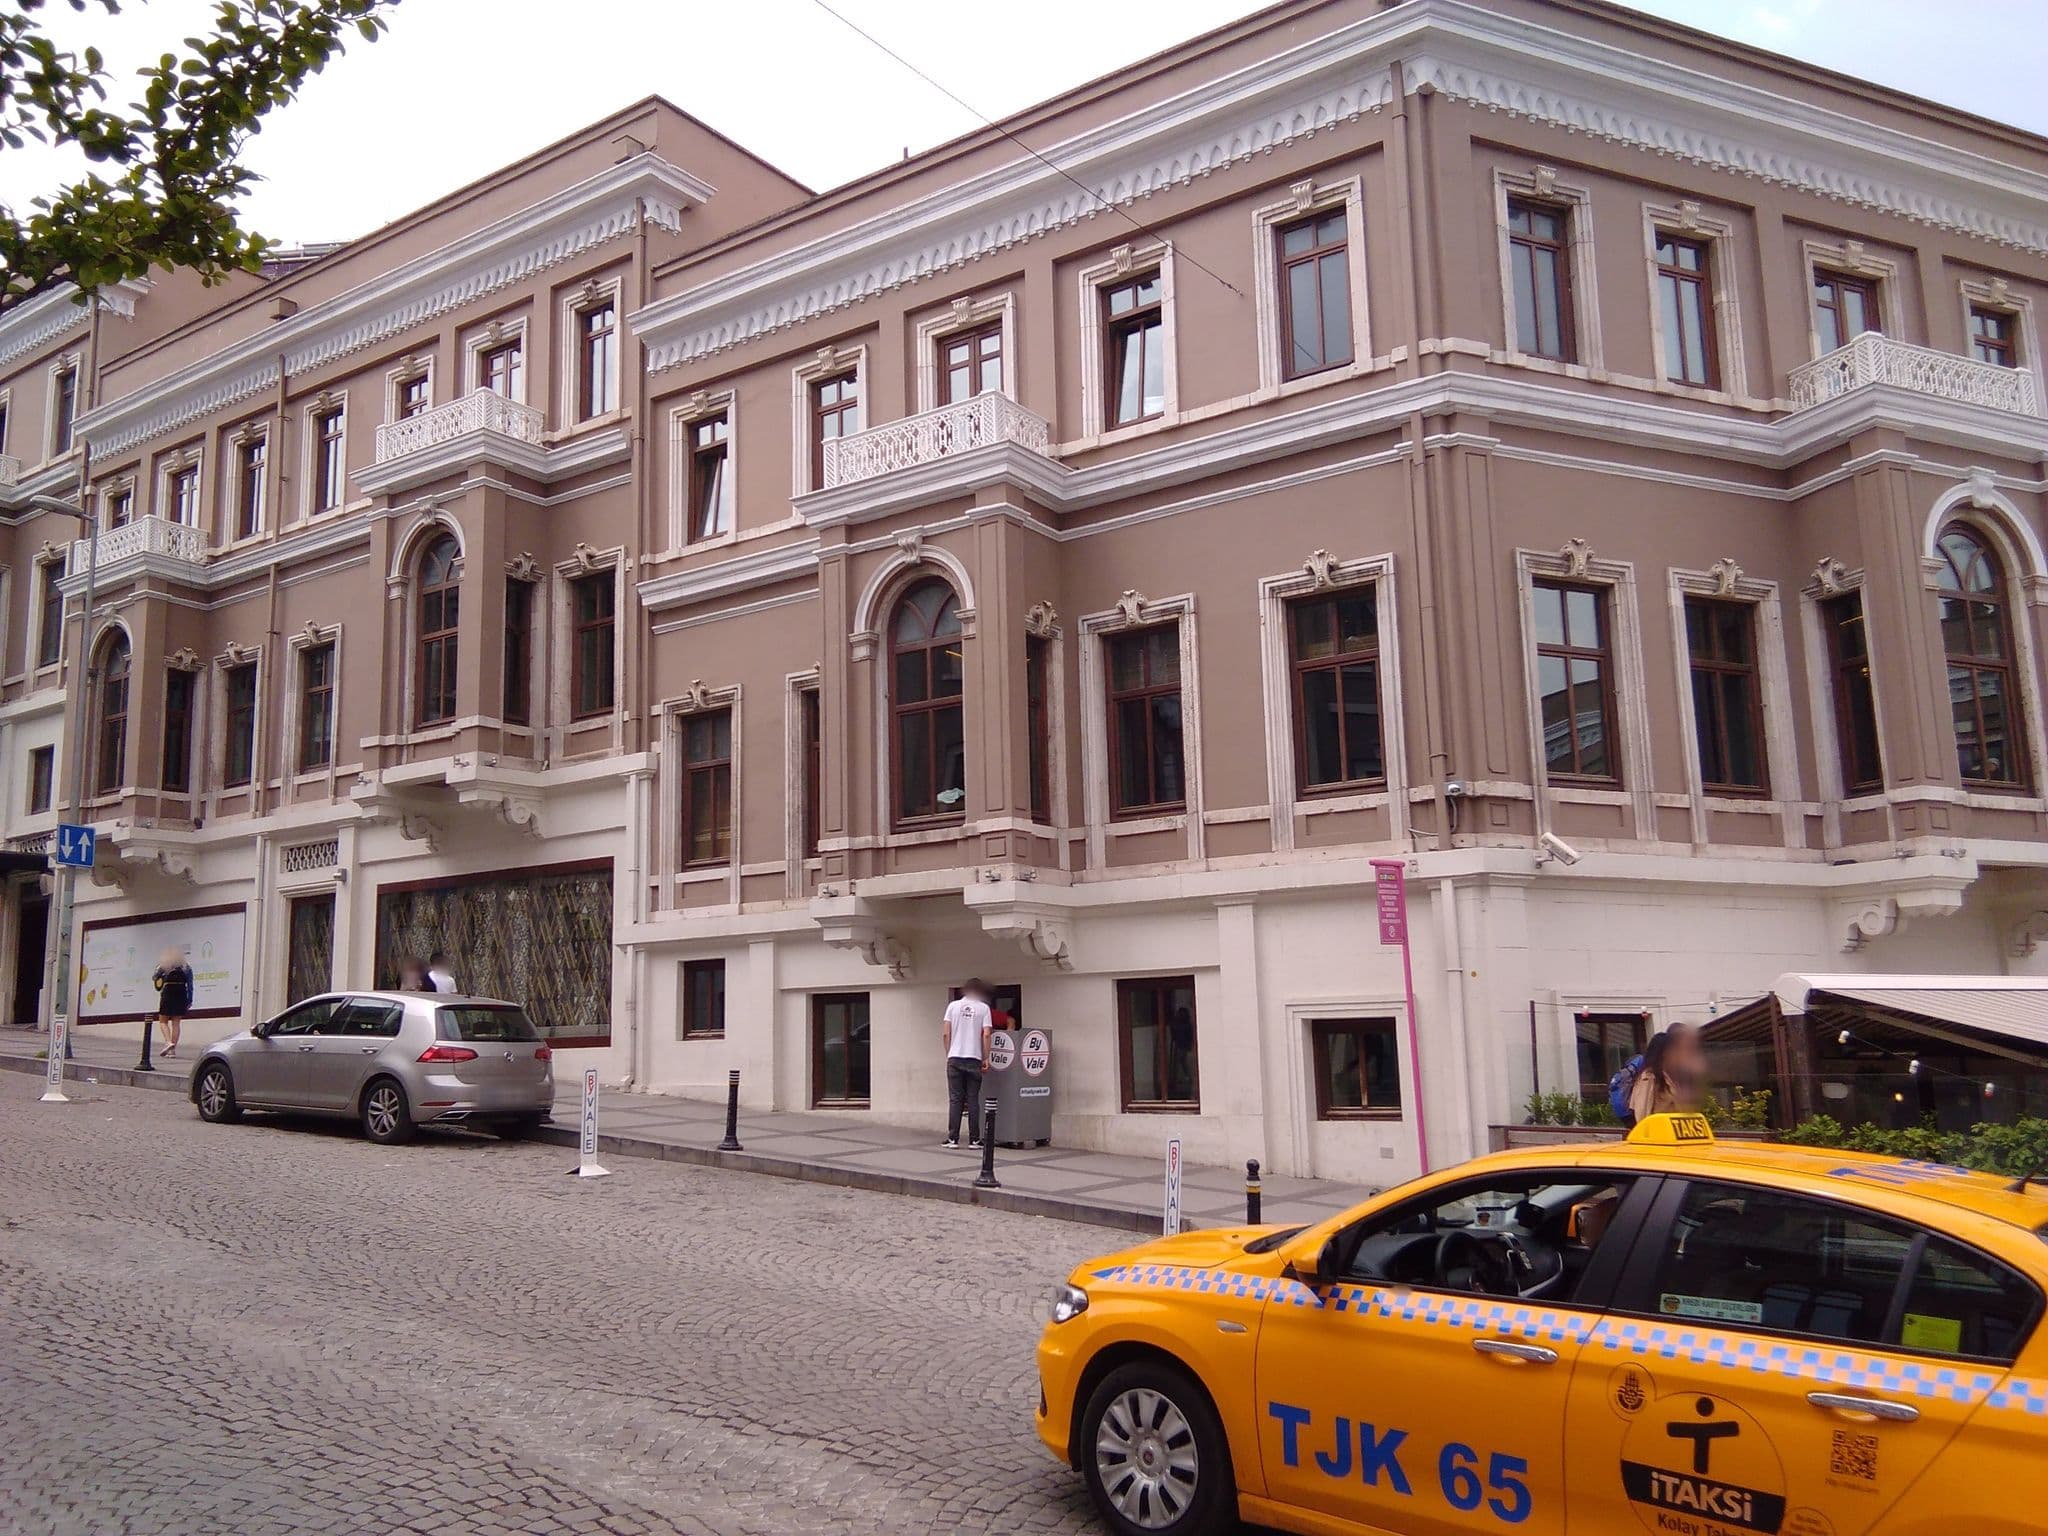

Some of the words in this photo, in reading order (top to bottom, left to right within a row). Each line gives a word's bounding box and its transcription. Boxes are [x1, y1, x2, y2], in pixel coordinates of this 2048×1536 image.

[994, 1036, 1005, 1048] By
[1029, 1037, 1042, 1050] By
[53, 1042, 61, 1081] VALE
[990, 1052, 1008, 1064] Vale
[1026, 1057, 1045, 1069] Vale
[586, 1098, 594, 1149] VALE
[1268, 1401, 1413, 1496] TJK
[1438, 1442, 1533, 1523] 65
[1657, 1512, 1700, 1536] Kolay
